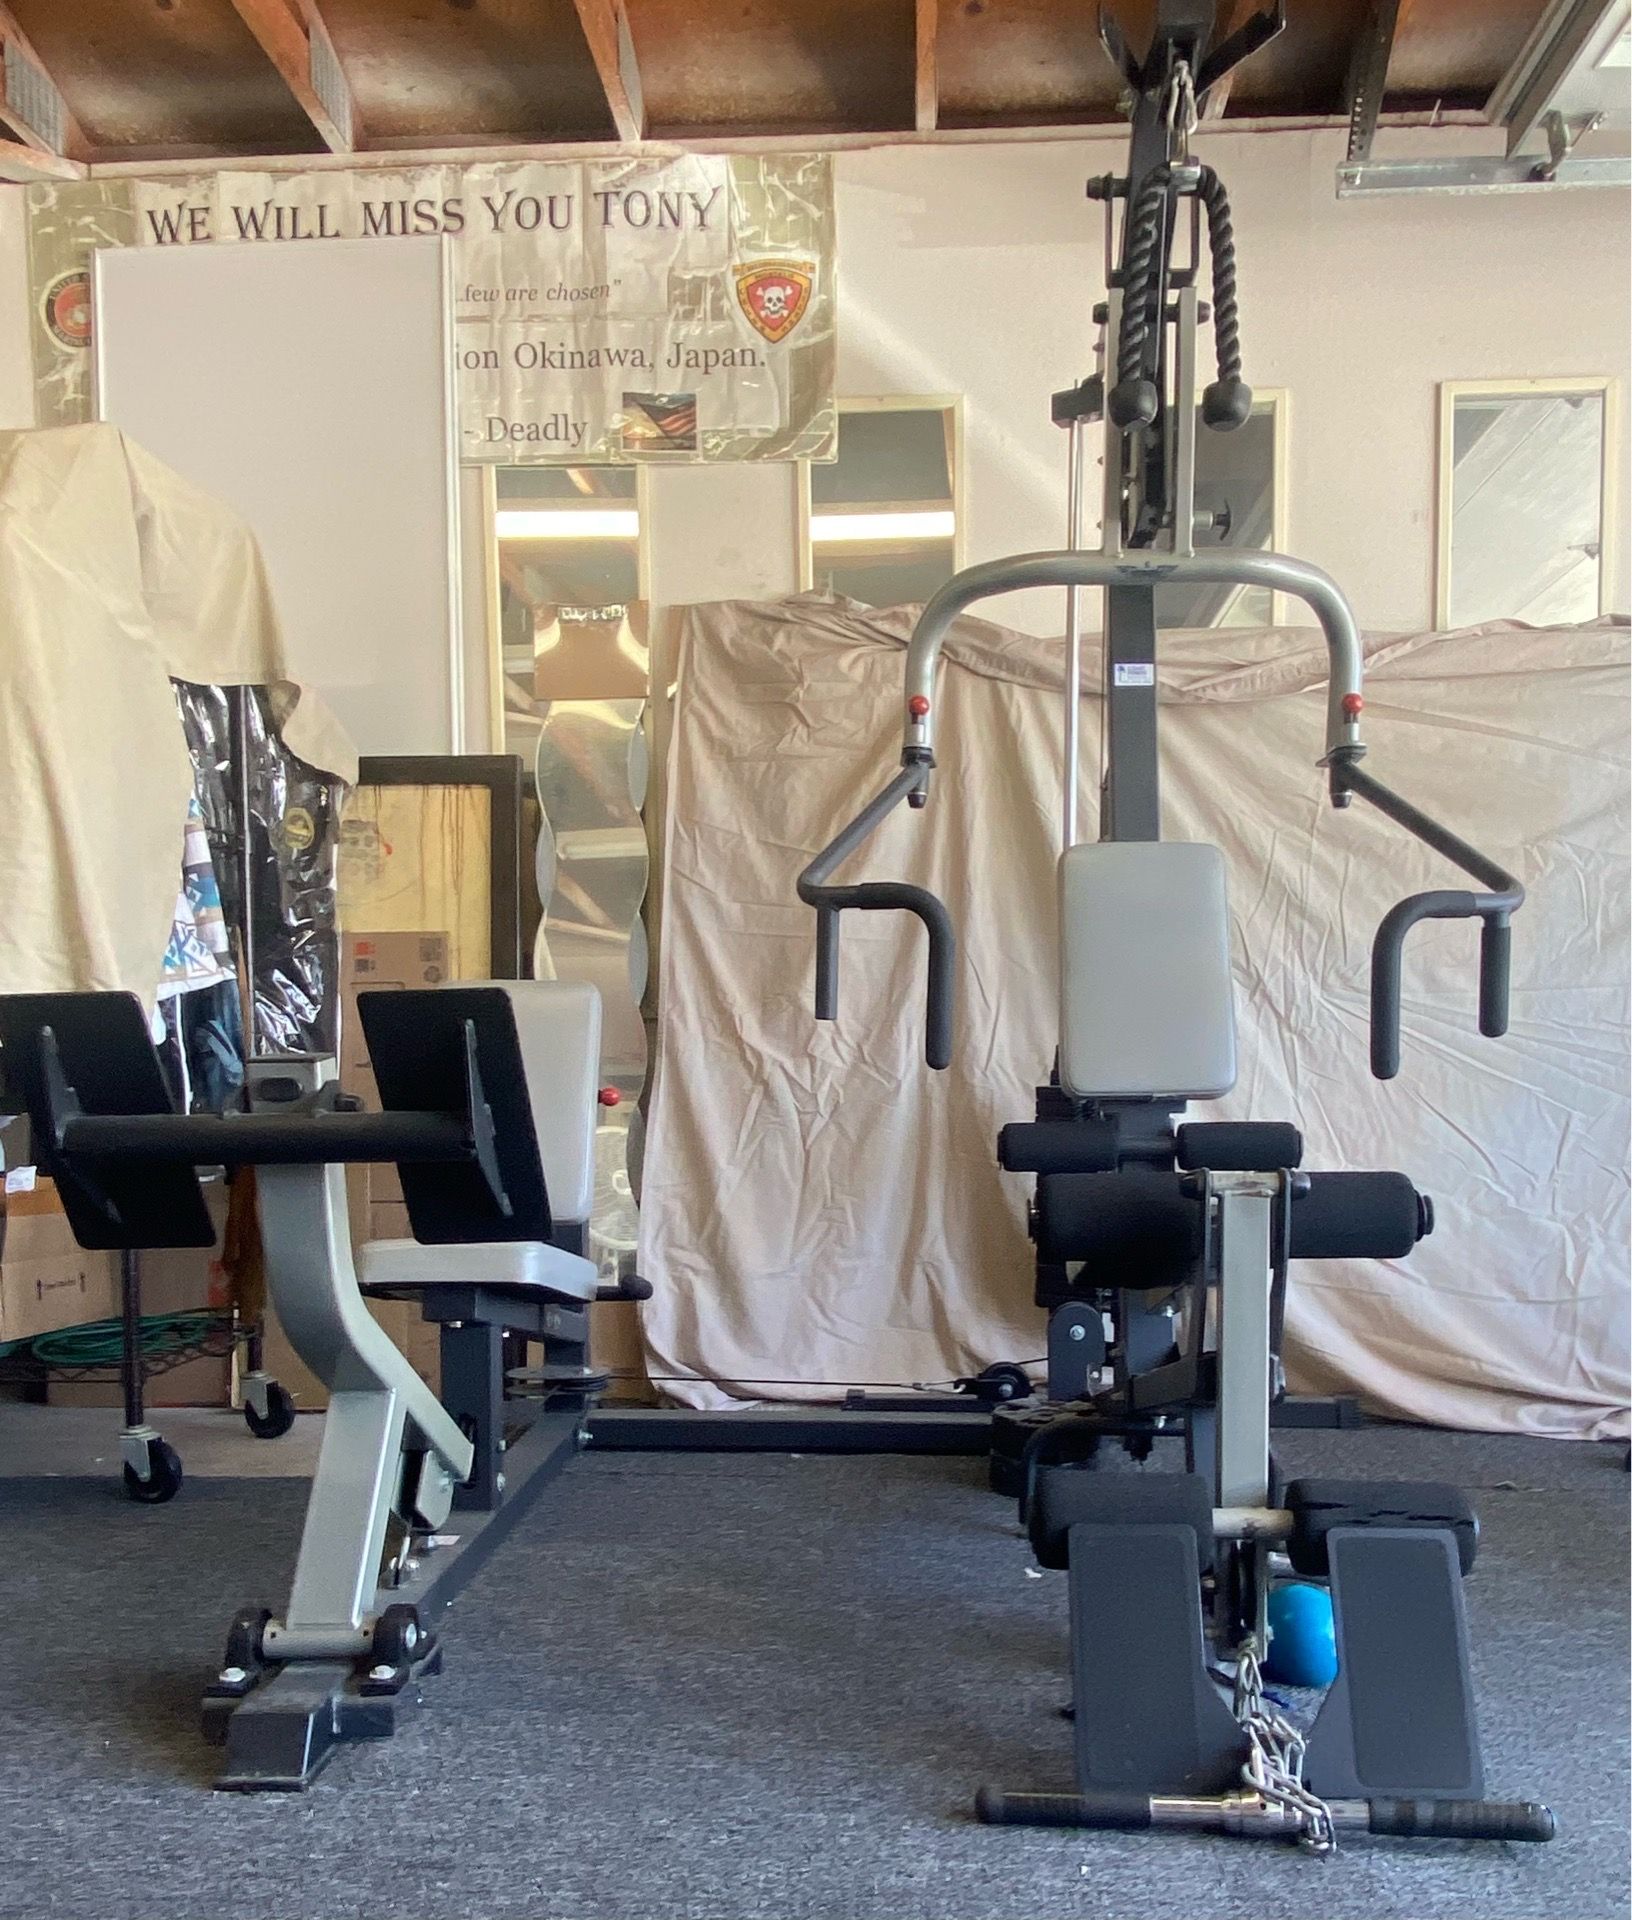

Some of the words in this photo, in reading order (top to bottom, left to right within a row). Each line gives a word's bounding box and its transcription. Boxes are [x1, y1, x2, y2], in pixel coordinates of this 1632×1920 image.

[146, 201, 212, 243] WE
[231, 199, 341, 239] WILL
[362, 198, 466, 236] MISS
[482, 191, 573, 231] YOU
[593, 185, 723, 230] TONY
[505, 285, 538, 302] are
[545, 278, 623, 304] chosen"
[514, 341, 655, 373] Okinawa,
[666, 344, 767, 376] Japan.
[486, 413, 589, 447] Deadly
